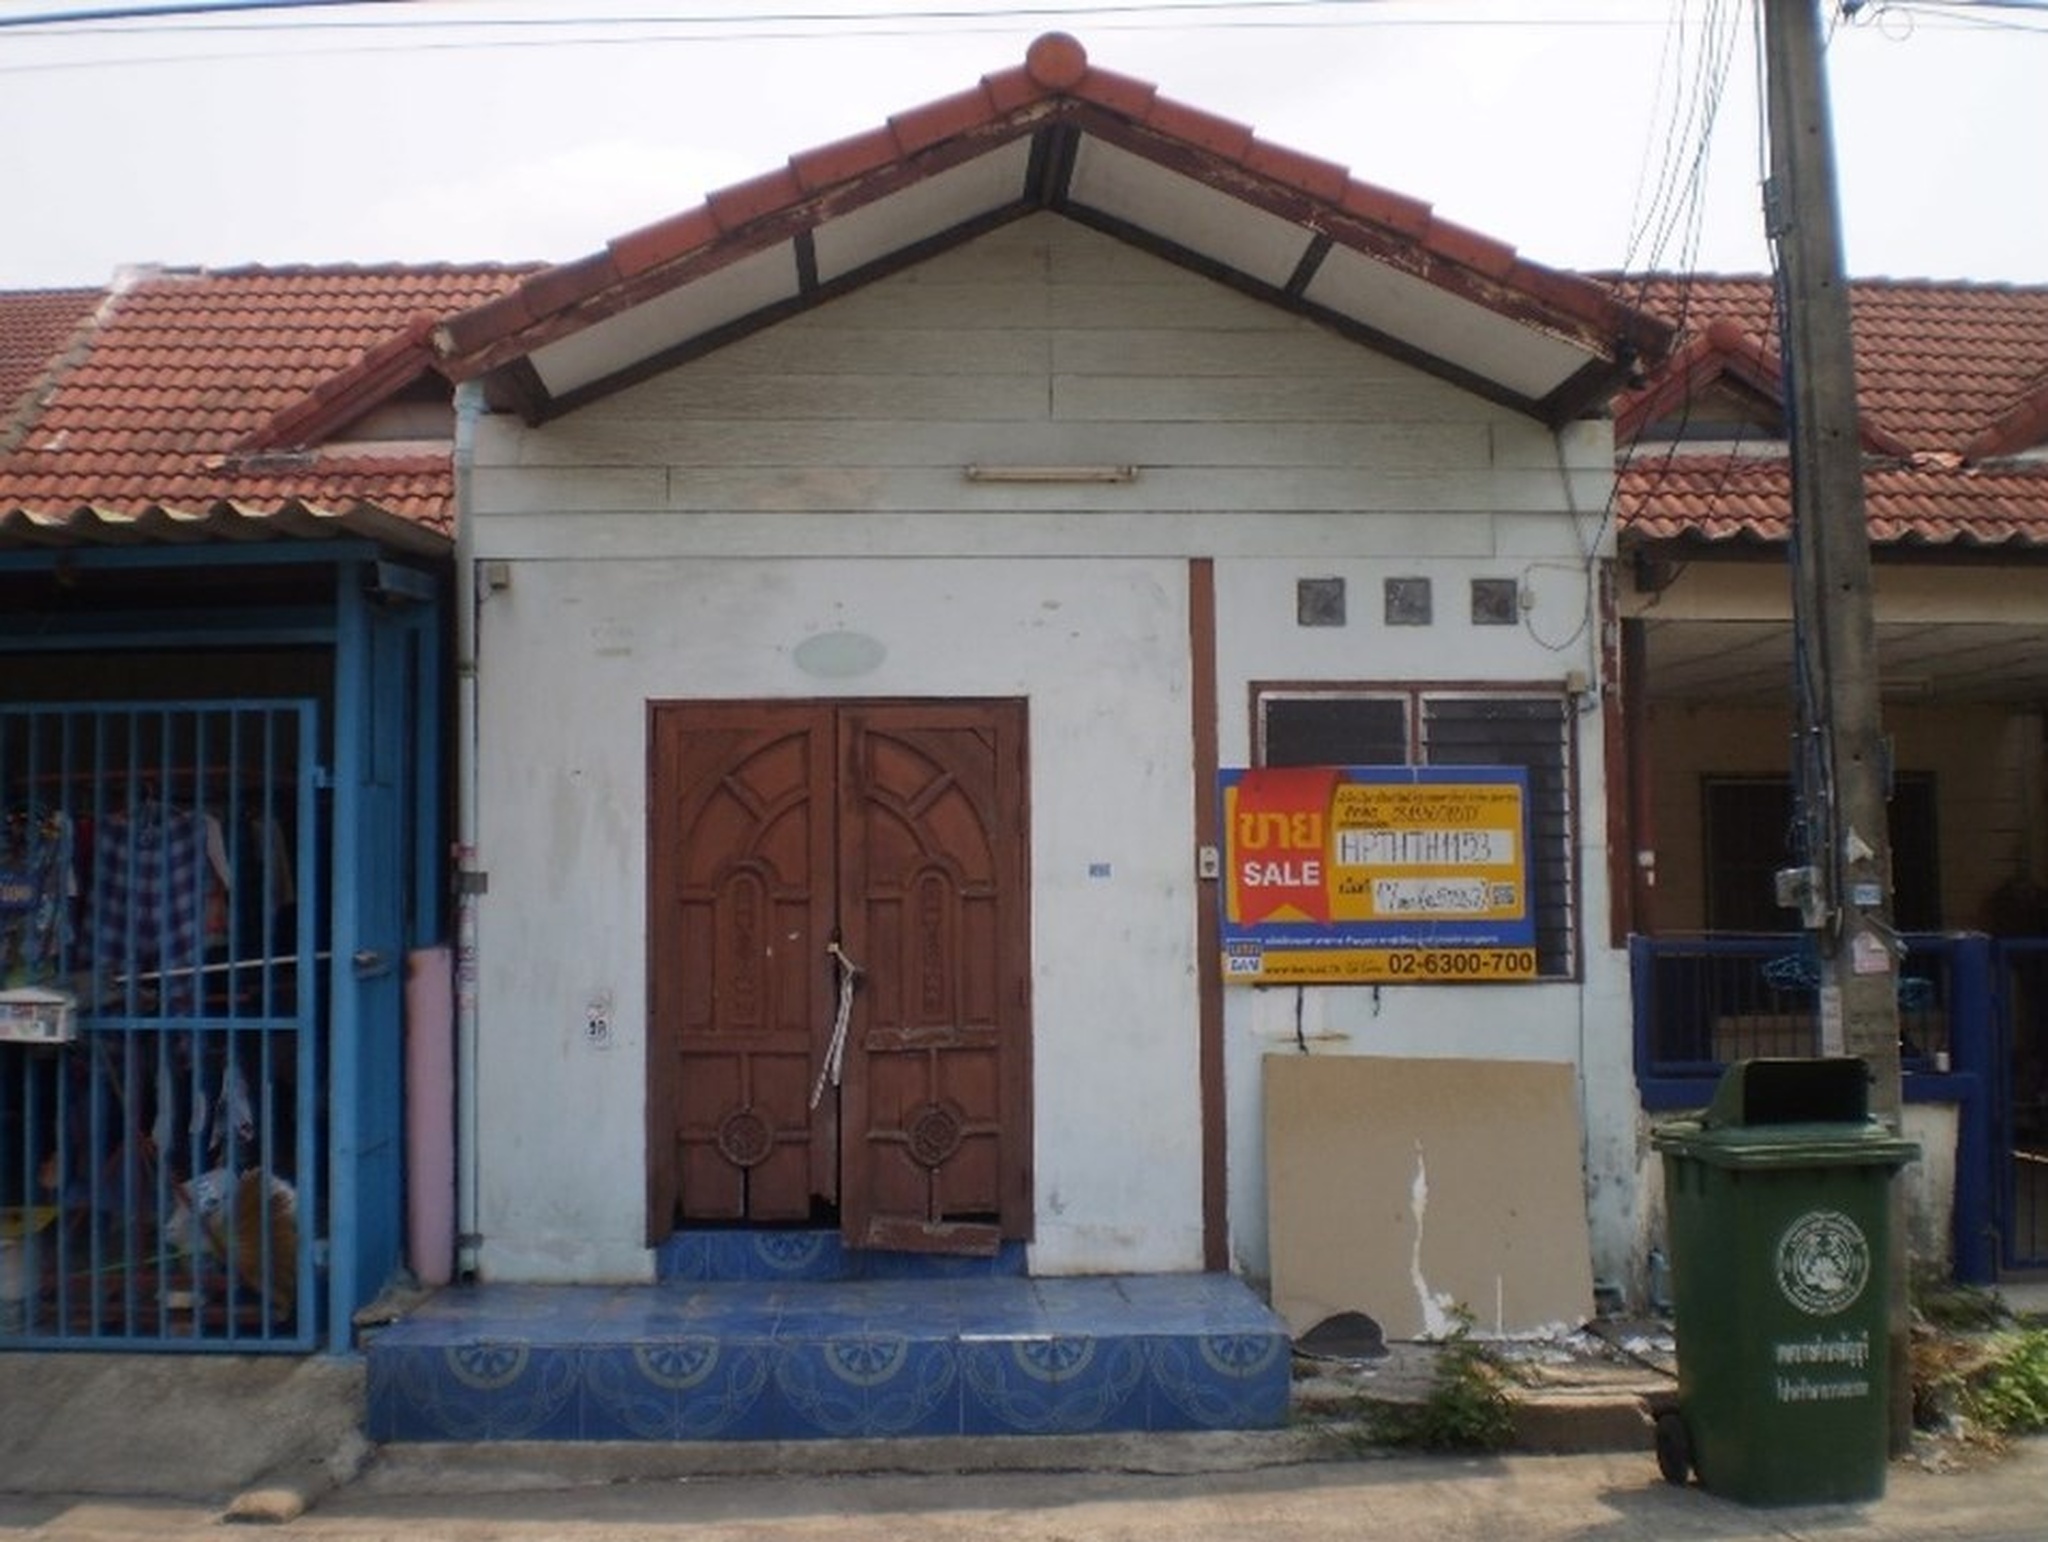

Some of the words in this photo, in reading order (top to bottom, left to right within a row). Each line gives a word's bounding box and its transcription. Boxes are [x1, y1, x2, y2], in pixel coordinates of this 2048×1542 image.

[1239, 812, 1321, 849] ขาย
[1243, 860, 1321, 887] SALE
[1389, 952, 1532, 974] 02-6300-700
